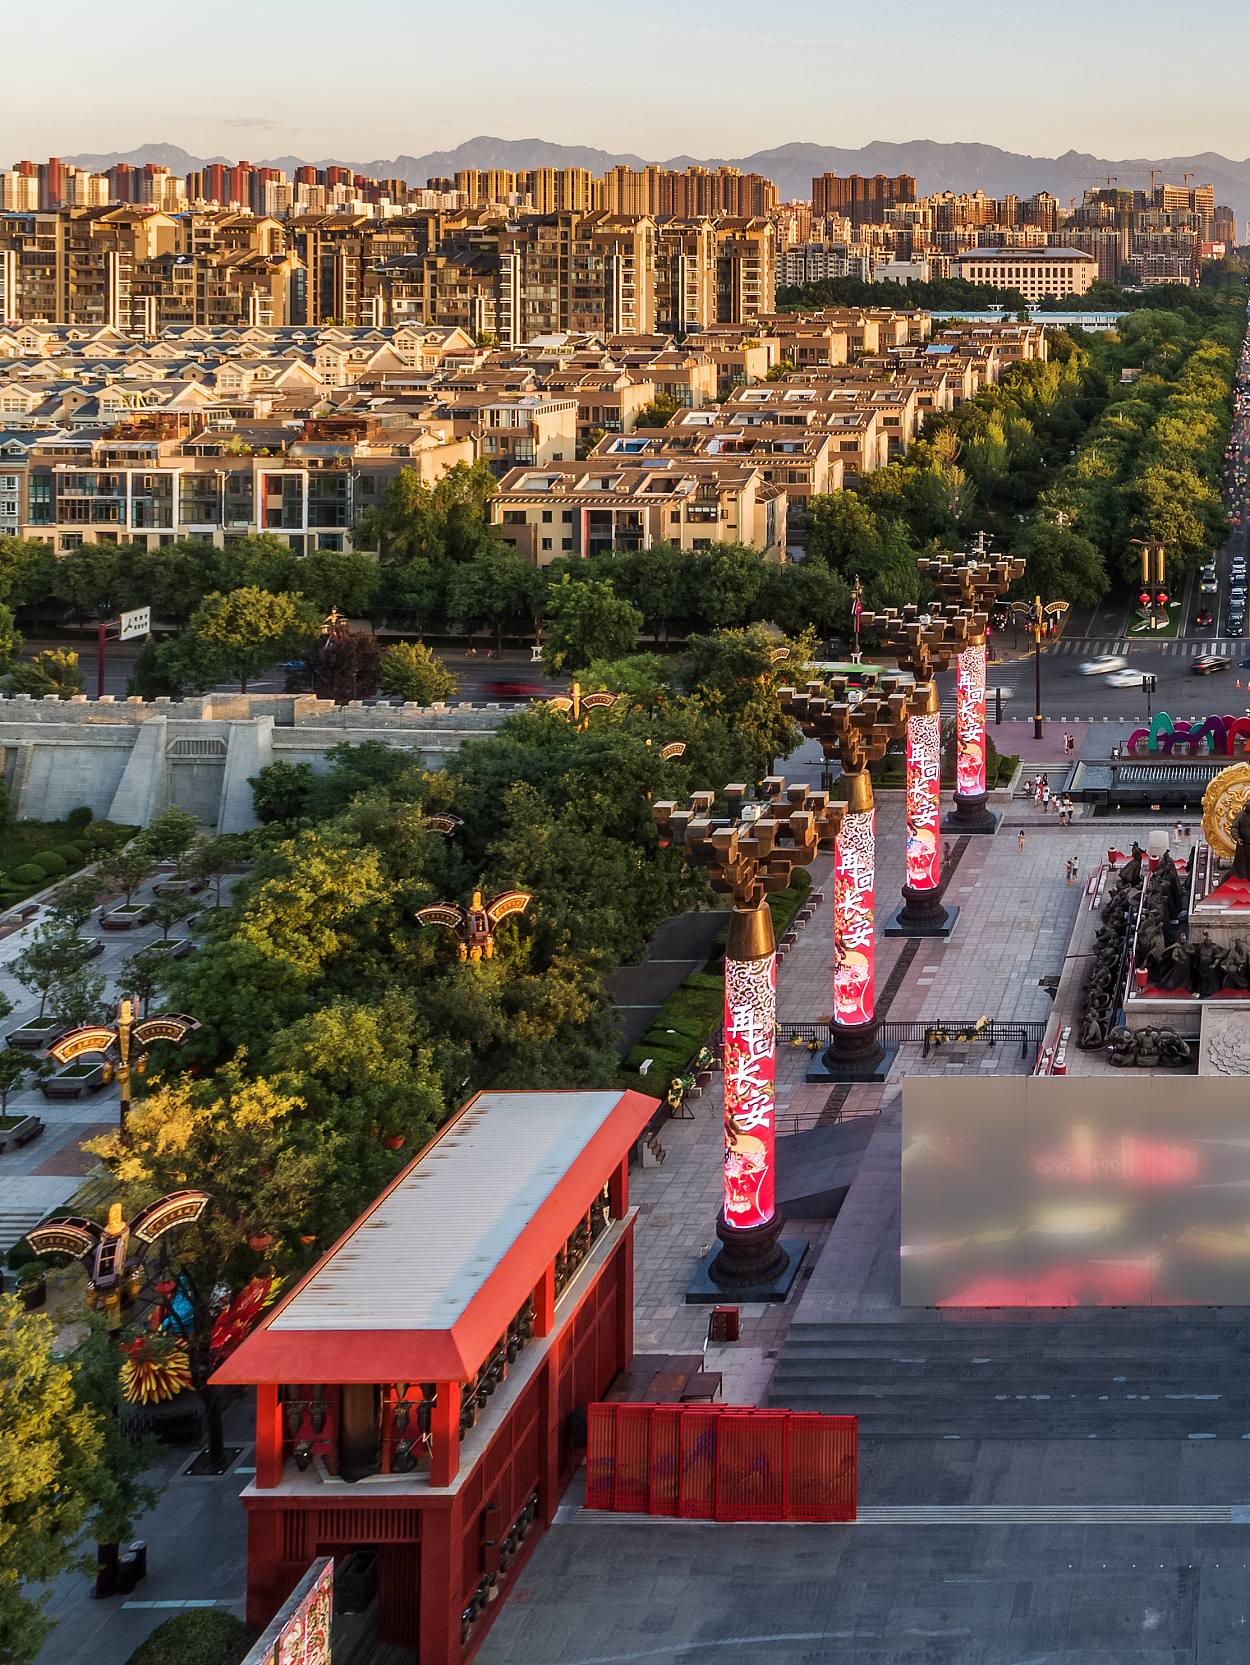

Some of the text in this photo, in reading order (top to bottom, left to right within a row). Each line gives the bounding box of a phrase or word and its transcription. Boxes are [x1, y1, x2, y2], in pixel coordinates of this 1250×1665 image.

[957, 670, 985, 743] 再回长安
[908, 743, 940, 827] 再回长安
[836, 848, 875, 949] 再回长安
[727, 1004, 775, 1132] 再回长安
